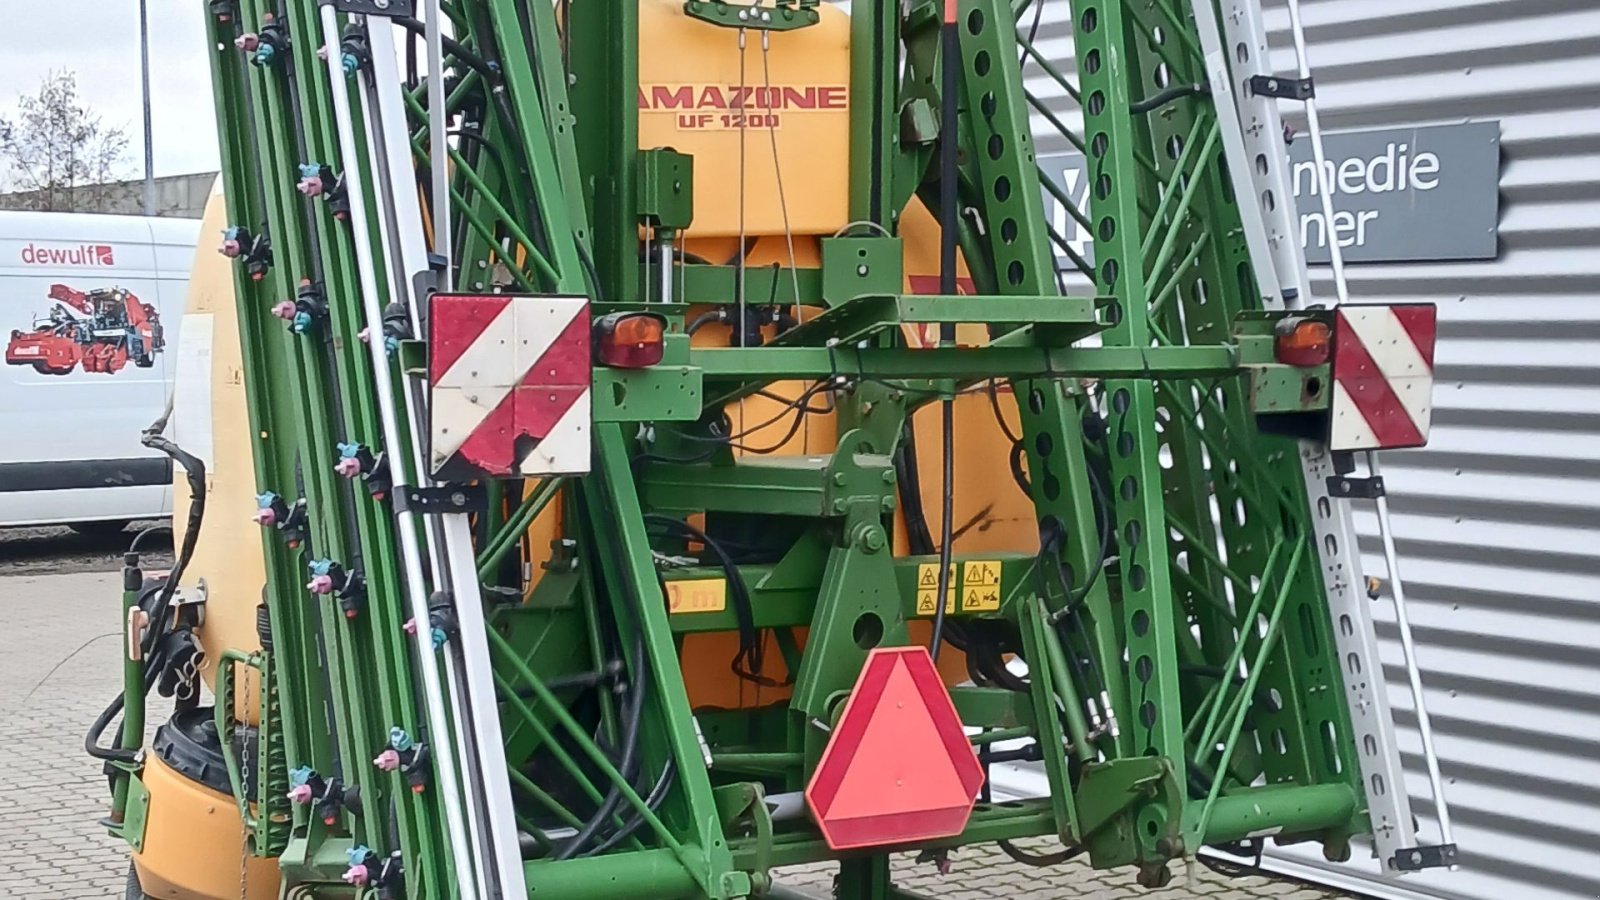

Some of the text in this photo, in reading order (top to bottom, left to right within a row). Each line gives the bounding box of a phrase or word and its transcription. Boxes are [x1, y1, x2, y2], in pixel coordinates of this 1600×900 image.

[679, 114, 780, 128] UF 1200
[22, 244, 95, 265] dewulf
